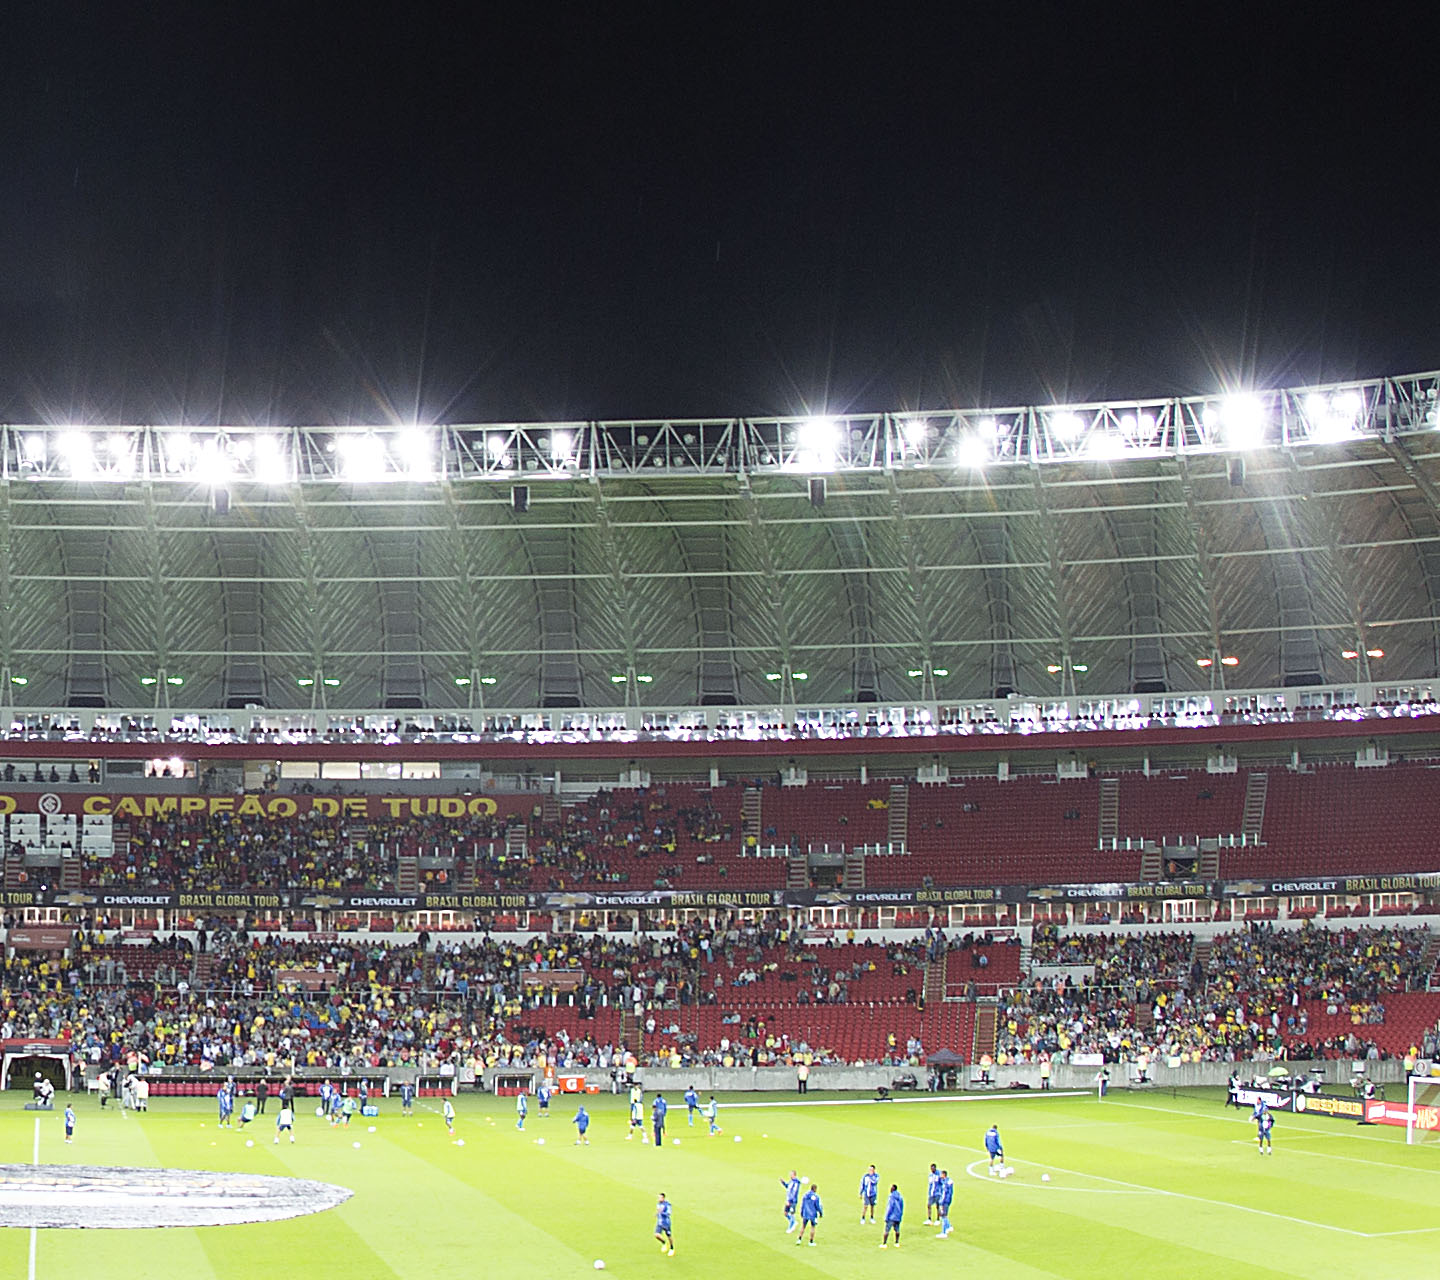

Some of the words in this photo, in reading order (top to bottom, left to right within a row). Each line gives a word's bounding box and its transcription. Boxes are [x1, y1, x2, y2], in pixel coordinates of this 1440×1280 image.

[83, 794, 298, 817] CAMPEÃO
[313, 798, 368, 818] DE
[383, 797, 497, 816] TUDO
[1272, 881, 1337, 892] CHEVROLET
[1346, 879, 1378, 890] BRASIL
[1381, 878, 1416, 889] GLOBAL
[856, 893, 912, 901] CHEVROLET
[916, 890, 942, 902] BRASIL
[944, 890, 972, 900] GLOBAL
[973, 889, 993, 899] TOUR
[1068, 888, 1123, 897] CHEVROLET
[1128, 886, 1153, 896] BRASIL
[1155, 886, 1183, 896] GLOBAL
[1185, 885, 1204, 895] TOUR
[8, 893, 32, 904] TOUR
[104, 896, 170, 904] CHEVROLET
[180, 895, 212, 905] BRASIL
[216, 895, 252, 906] GLOBAL
[254, 895, 279, 906] TOUR
[351, 898, 417, 906] CHEVROLET
[426, 896, 459, 907] BRASIL
[462, 896, 498, 907] GLOBAL
[500, 896, 525, 906] TOUR
[596, 896, 662, 904] CHEVROLET
[671, 894, 704, 904] BRASIL
[707, 894, 743, 904] GLOBAL
[745, 893, 770, 904] TOUR
